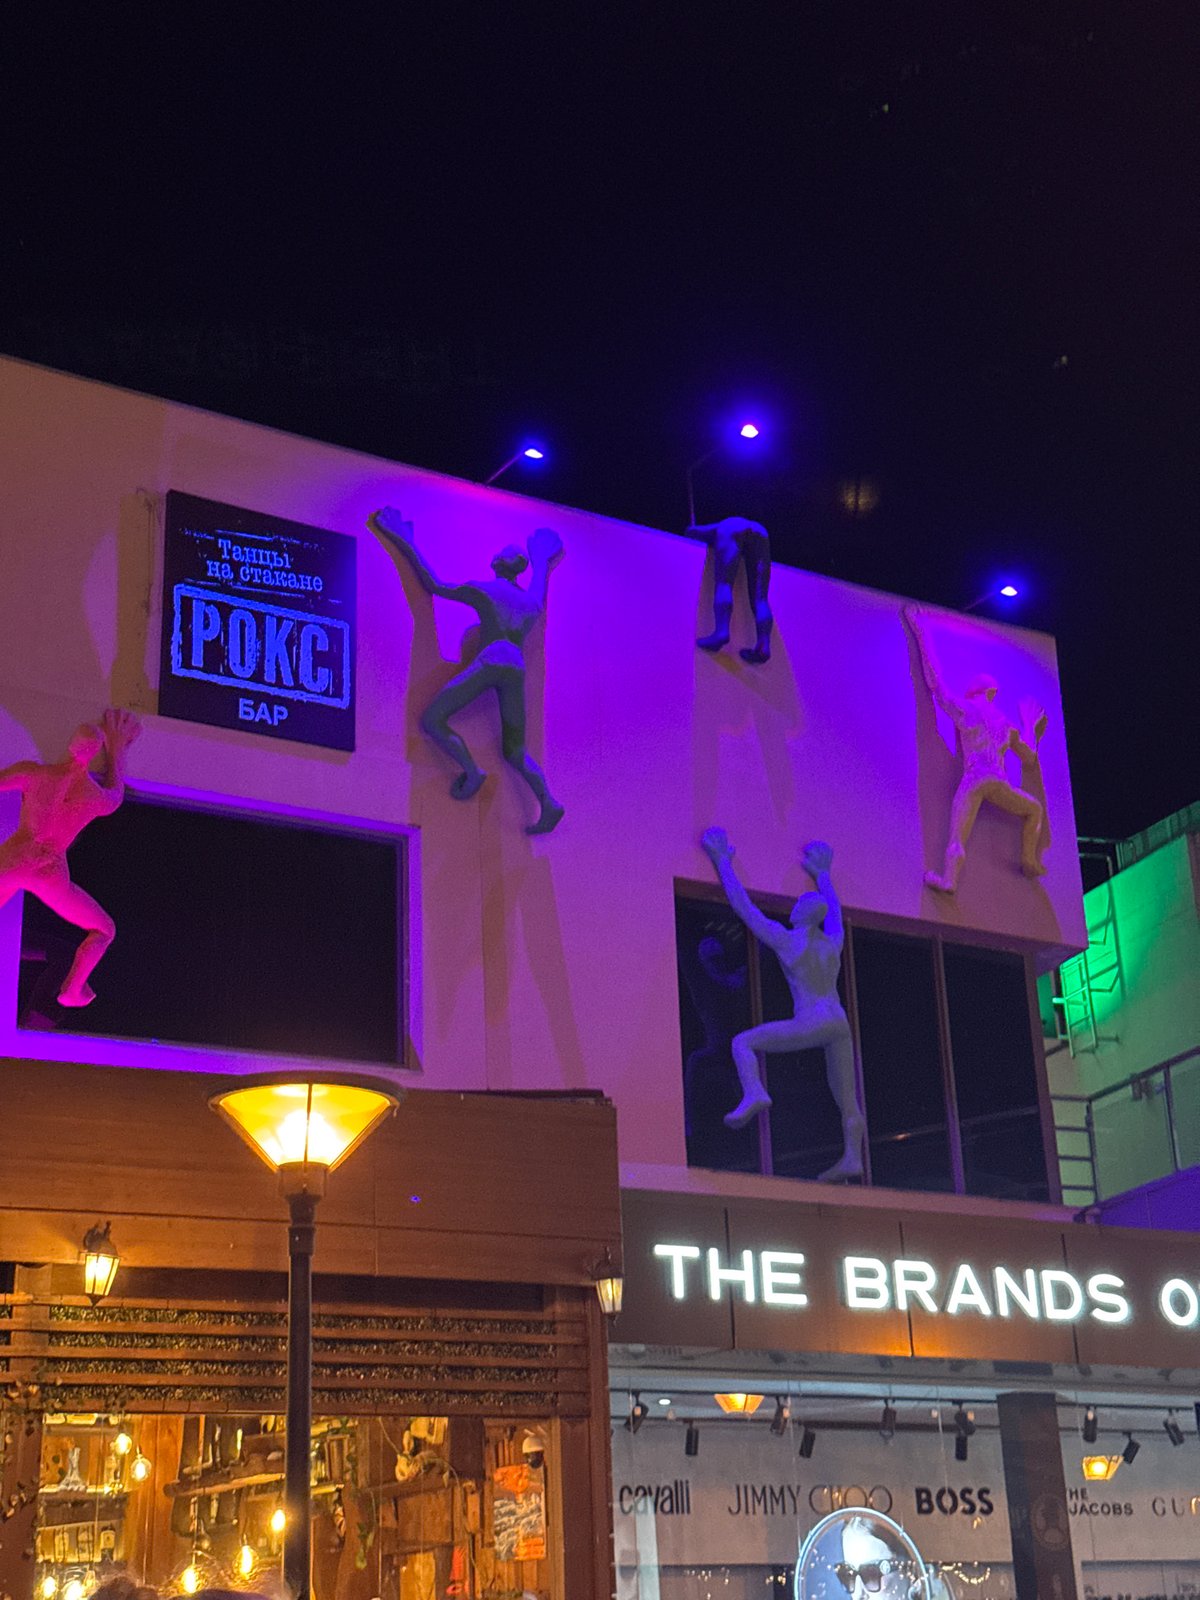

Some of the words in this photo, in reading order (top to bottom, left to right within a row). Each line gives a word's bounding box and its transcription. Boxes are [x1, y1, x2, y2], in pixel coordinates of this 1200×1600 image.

[218, 538, 292, 569] Танцы
[206, 559, 234, 579] на
[240, 564, 323, 592] стакане
[191, 600, 329, 693] РОКС
[239, 698, 288, 726] БАР
[654, 1244, 808, 1305] THE
[843, 1256, 1128, 1322] BRANDS
[1160, 1278, 1200, 1326] O
[619, 1479, 690, 1515] cavalli
[728, 1484, 800, 1516] JIMMY
[809, 1484, 893, 1515] CHOO
[915, 1486, 994, 1515] BOSS
[1066, 1487, 1088, 1500] HE
[1068, 1503, 1134, 1516] JACOBS
